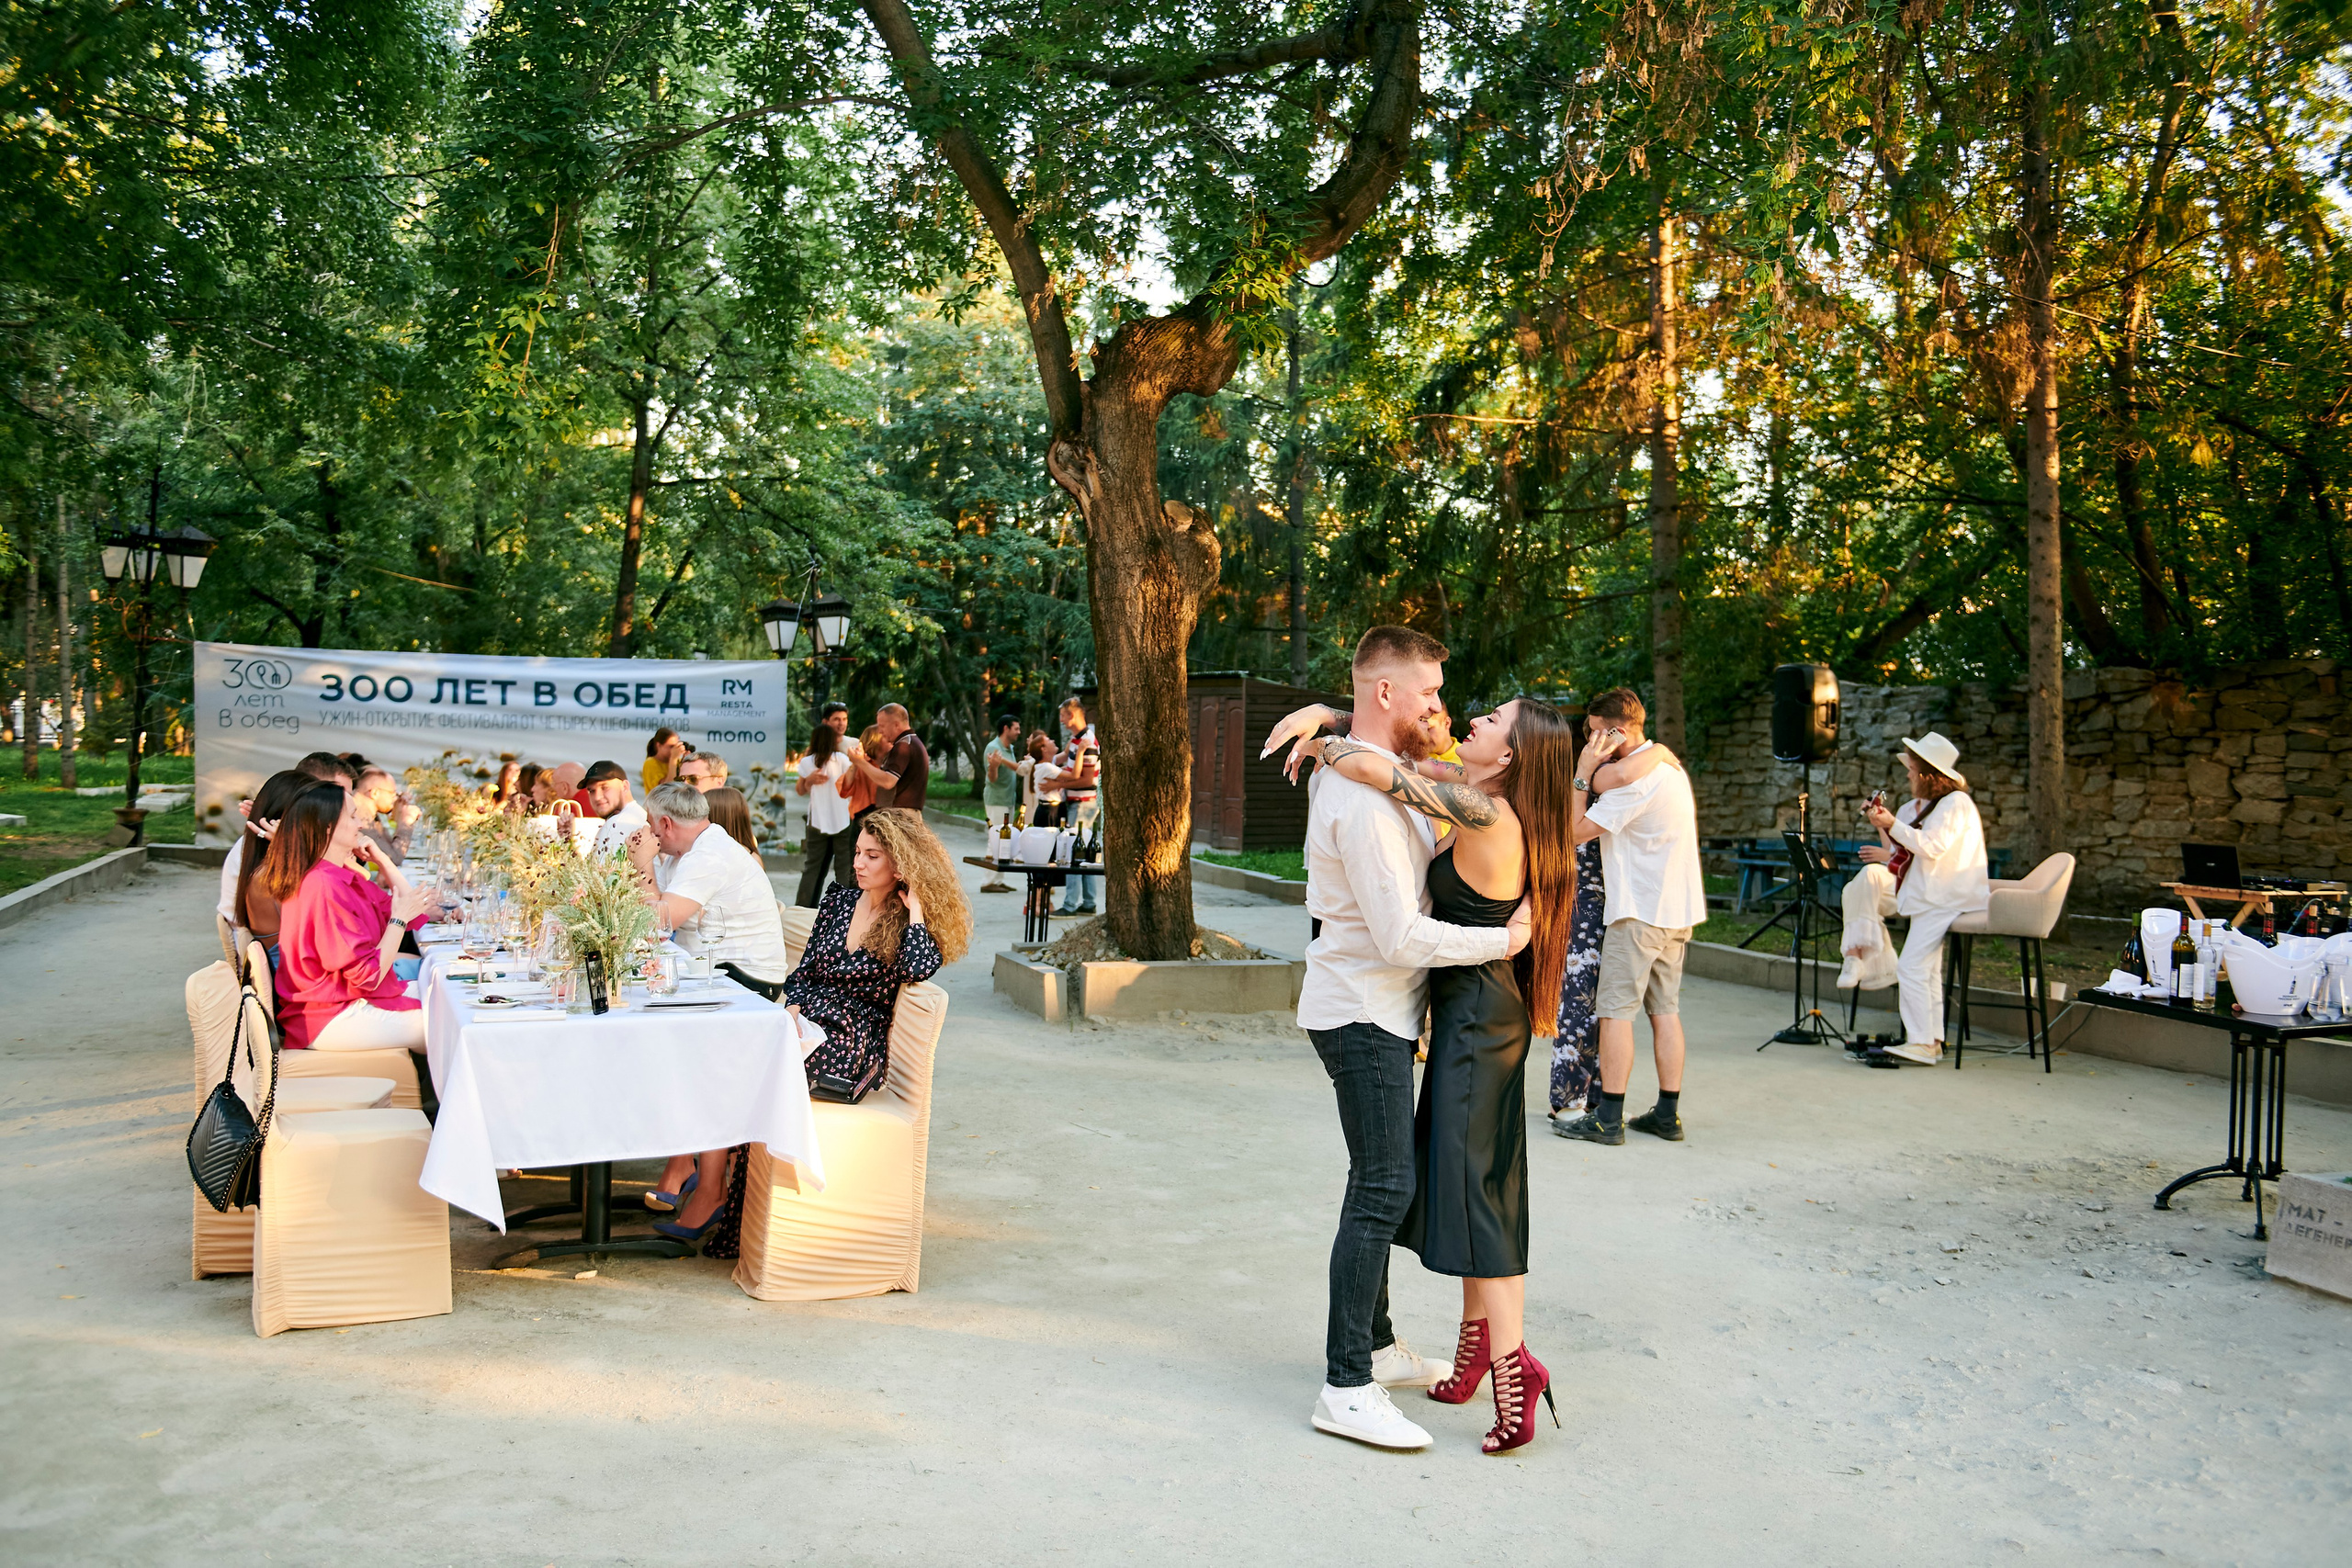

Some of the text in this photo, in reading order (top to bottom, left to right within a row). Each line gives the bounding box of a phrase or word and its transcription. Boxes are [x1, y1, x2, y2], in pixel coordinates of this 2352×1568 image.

[320, 673, 689, 714] 300 ЛЕТ В ОБЕД
[722, 679, 752, 694] RM
[319, 709, 691, 732] УЖИН-ОТКРЫТИЕ ФЕСТИВАЛЯ ОТ ЧЕТЫРЕХ ШЕФ-ПОВАРОВ
[707, 730, 766, 742] momo
